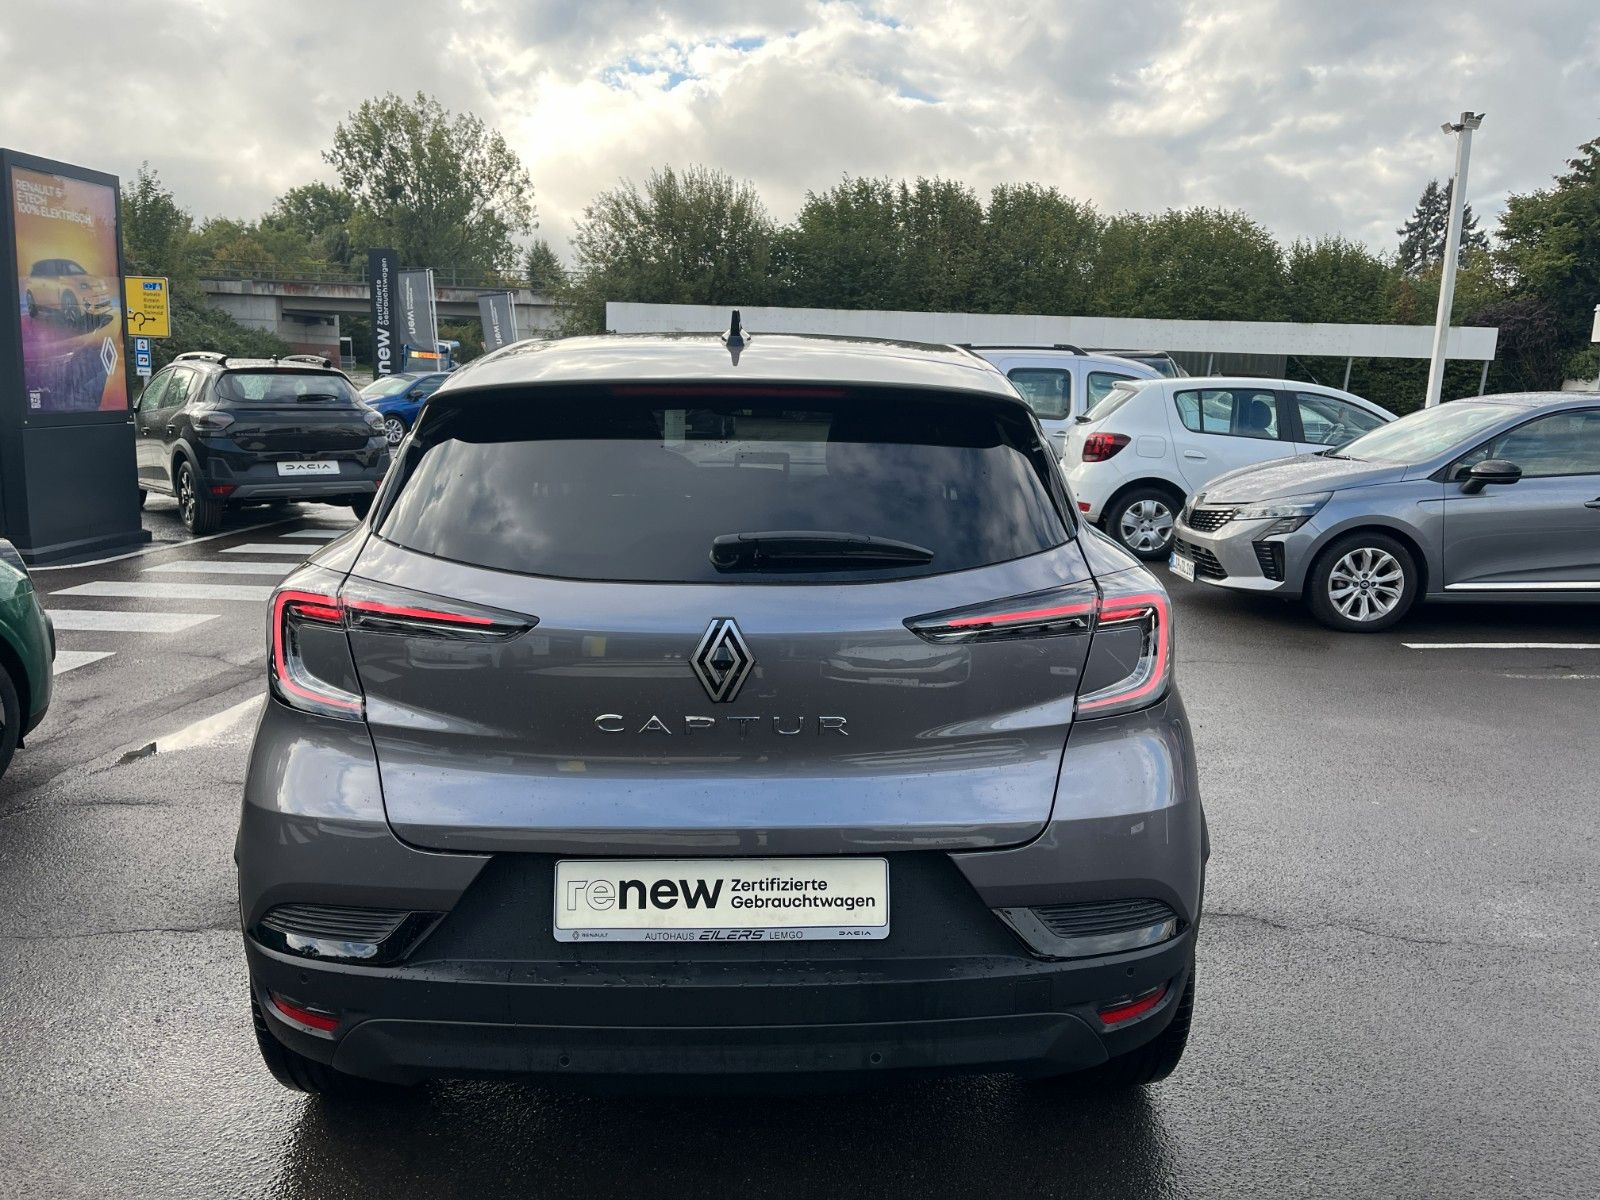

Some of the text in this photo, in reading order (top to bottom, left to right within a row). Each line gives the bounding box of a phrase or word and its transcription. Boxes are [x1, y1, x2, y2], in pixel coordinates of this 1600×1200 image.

[15, 179, 54, 197] RENAULT
[17, 202, 92, 225] 100% ELEKTRISCH
[382, 258, 390, 326] Gebrauchtwagen
[376, 327, 391, 378] new
[594, 713, 849, 736] CAPTUR
[566, 877, 828, 911] renew Zertifizierte
[730, 894, 876, 911] Gebrauchtwagen
[644, 930, 804, 941] AUTOHAUS EILERS LEMGO
